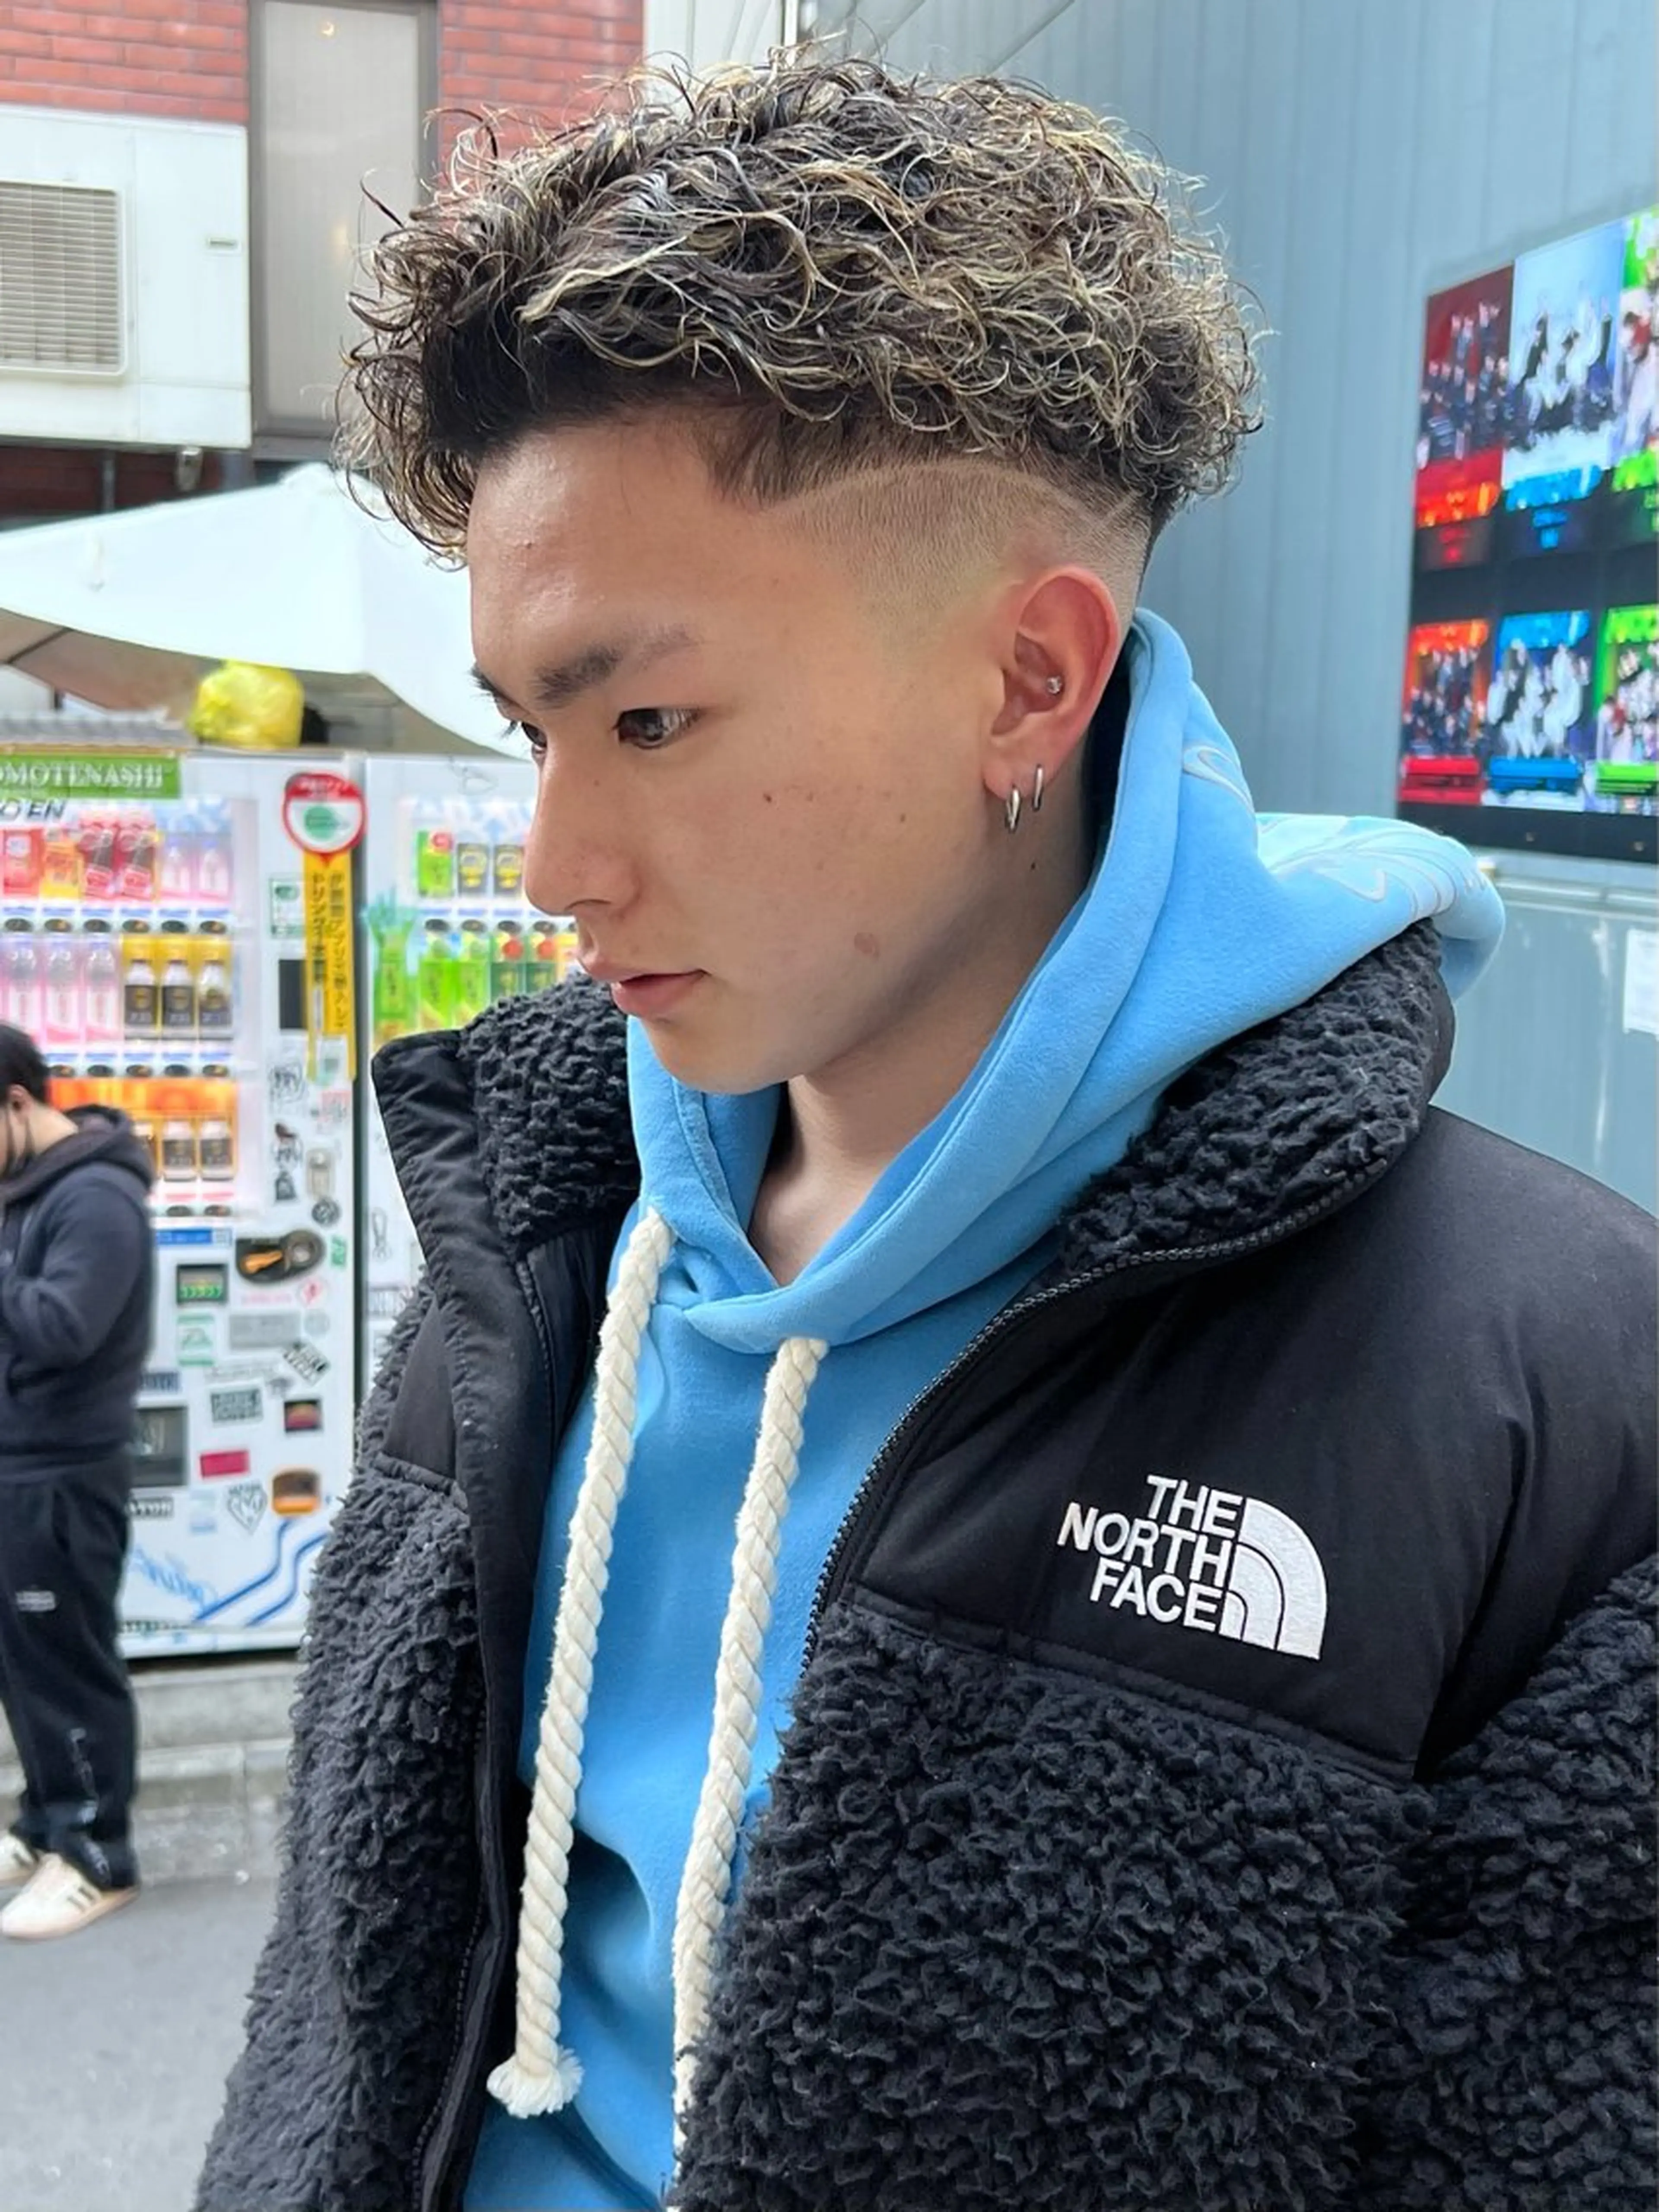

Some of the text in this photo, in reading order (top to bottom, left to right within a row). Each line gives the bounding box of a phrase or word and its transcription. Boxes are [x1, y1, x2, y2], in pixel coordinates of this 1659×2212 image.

[0, 762, 162, 788] MOTENASHI
[27, 798, 66, 820] EN
[1146, 1474, 1243, 1538] THE
[1057, 1502, 1232, 1588] NORTH
[1090, 1556, 1222, 1632] FACE
